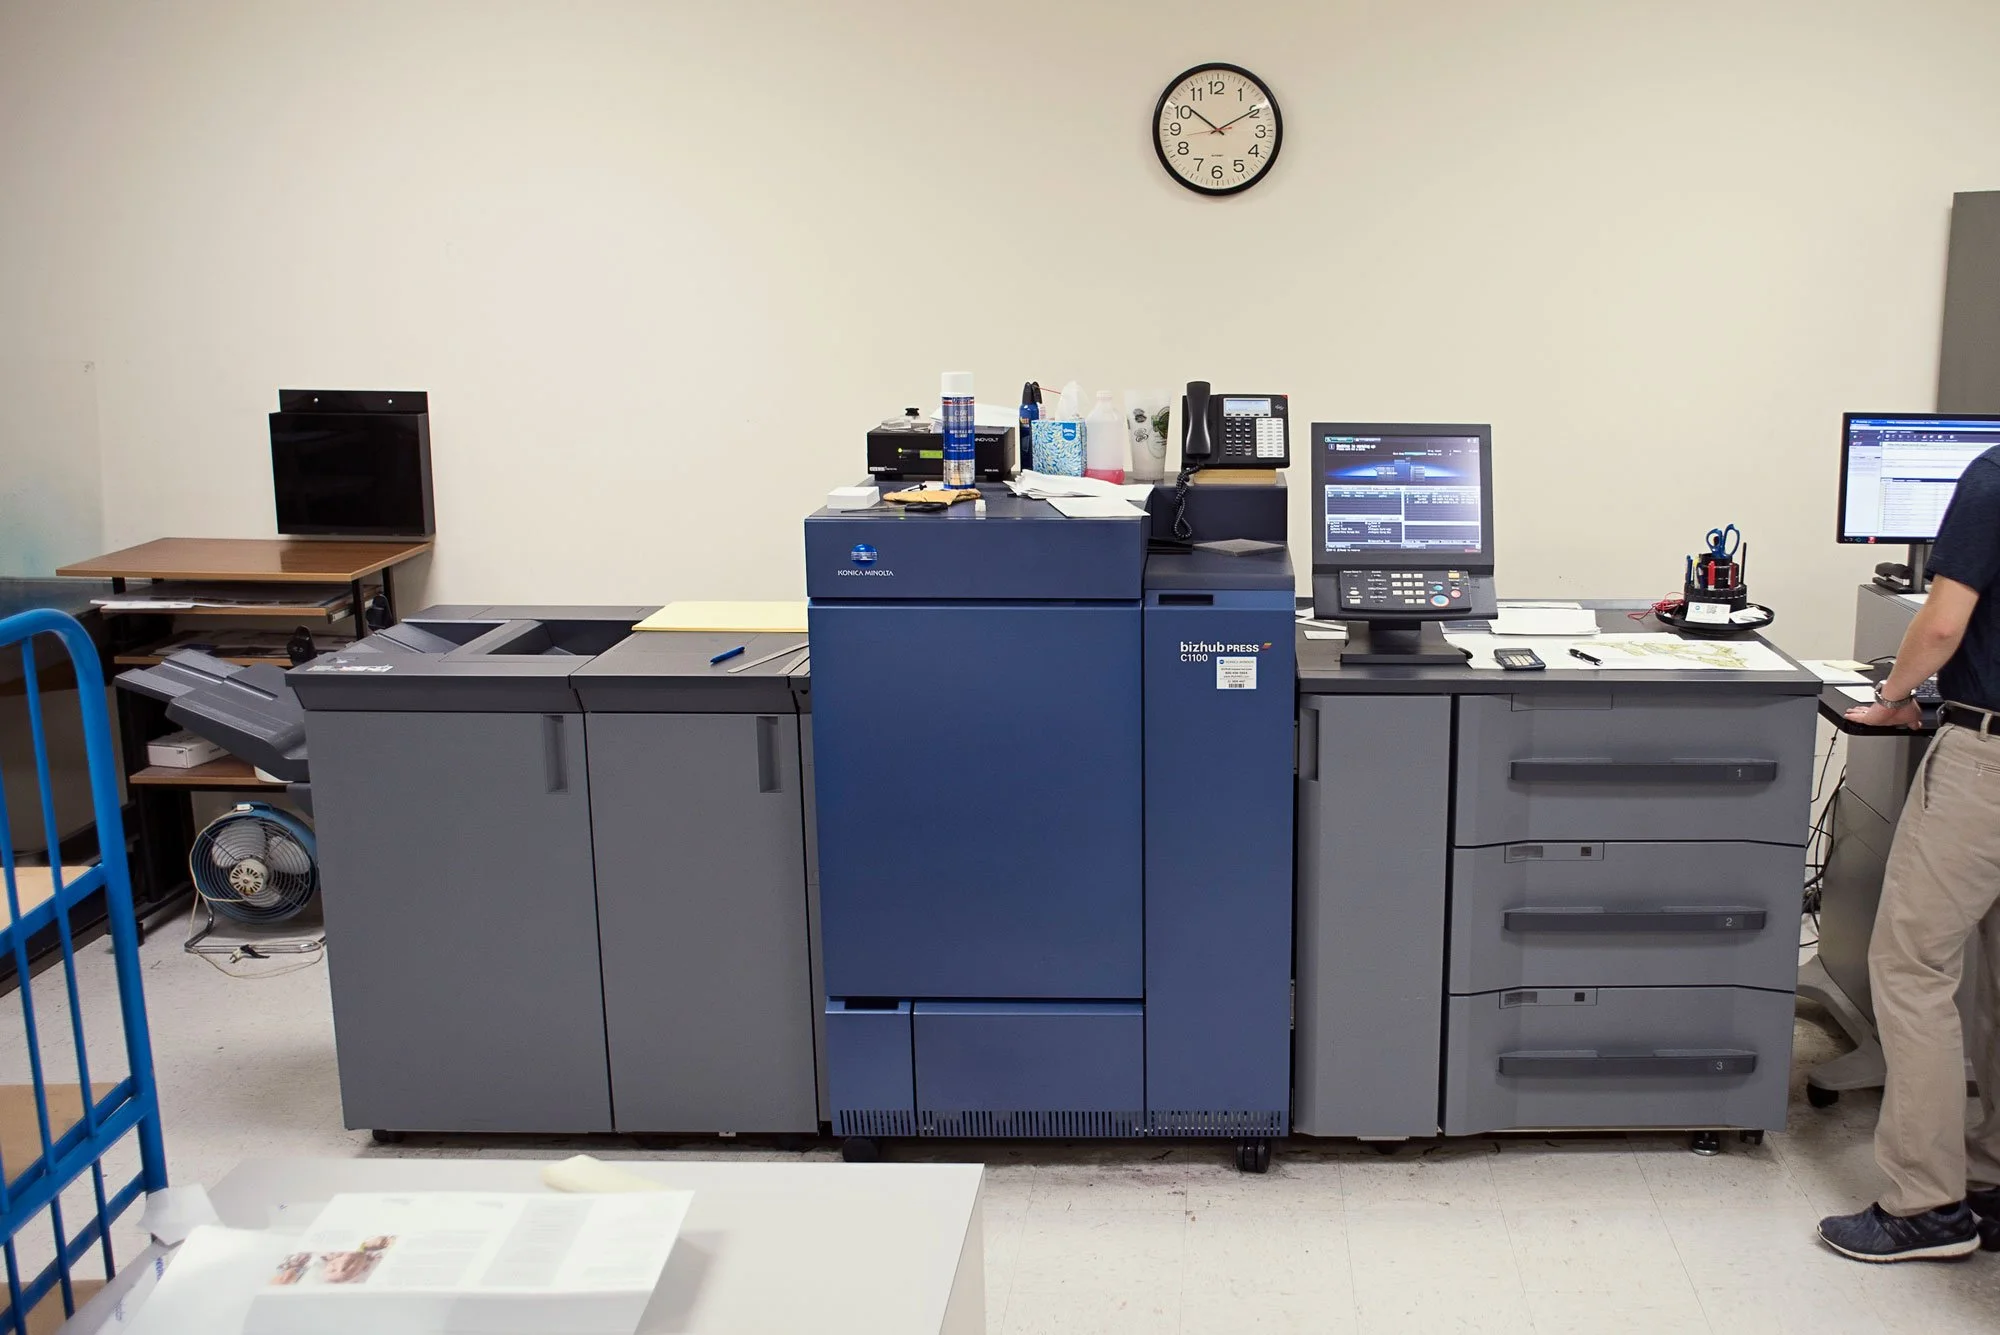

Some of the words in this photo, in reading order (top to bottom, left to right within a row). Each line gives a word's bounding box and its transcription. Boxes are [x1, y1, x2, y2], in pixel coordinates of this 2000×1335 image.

[1190, 87, 1203, 101] 11
[1208, 81, 1225, 95] 12
[1237, 88, 1243, 102] 1
[1174, 105, 1192, 119] 10
[1249, 105, 1260, 119] 2
[1169, 122, 1182, 136] 9
[1254, 124, 1266, 138] 3
[1177, 141, 1189, 155] 8
[1247, 143, 1260, 158] 4
[1193, 158, 1204, 172] 7
[1211, 165, 1223, 179] 6
[1233, 159, 1245, 173] 5
[1180, 641, 1225, 653] bizhub
[1226, 644, 1259, 653] PRESS
[1180, 653, 1208, 662] C1100
[1725, 917, 1733, 927] 2
[1716, 1061, 1723, 1071] 3
